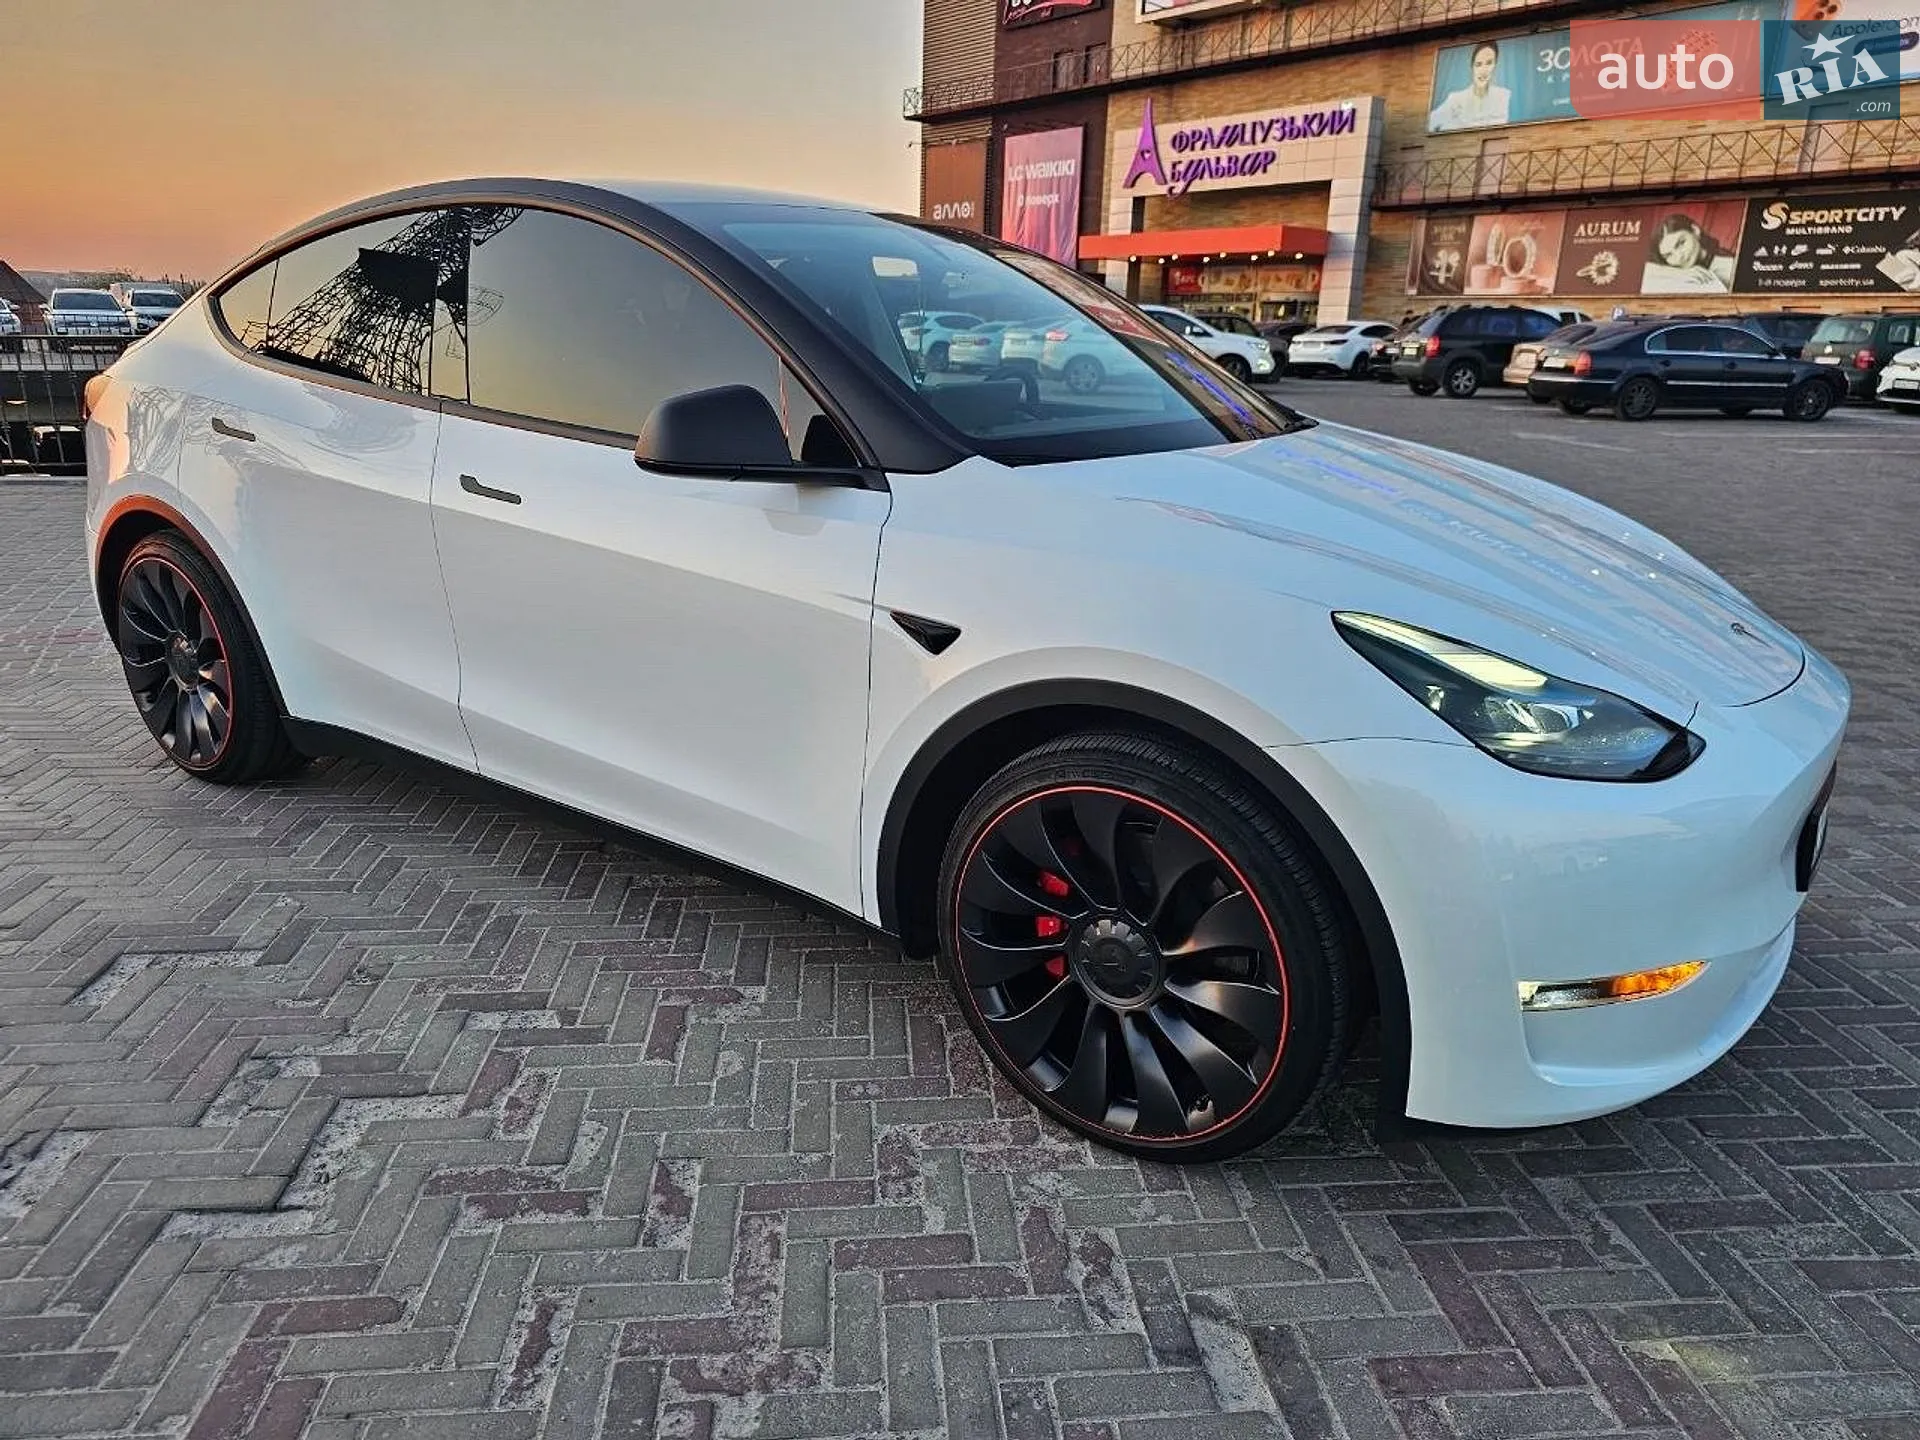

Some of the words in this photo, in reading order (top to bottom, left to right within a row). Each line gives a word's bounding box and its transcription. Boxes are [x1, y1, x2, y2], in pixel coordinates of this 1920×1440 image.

[1788, 206, 1907, 225] SPORTCITY
[1574, 221, 1641, 237] AURUM
[1785, 225, 1853, 236] MULTIBRAND
